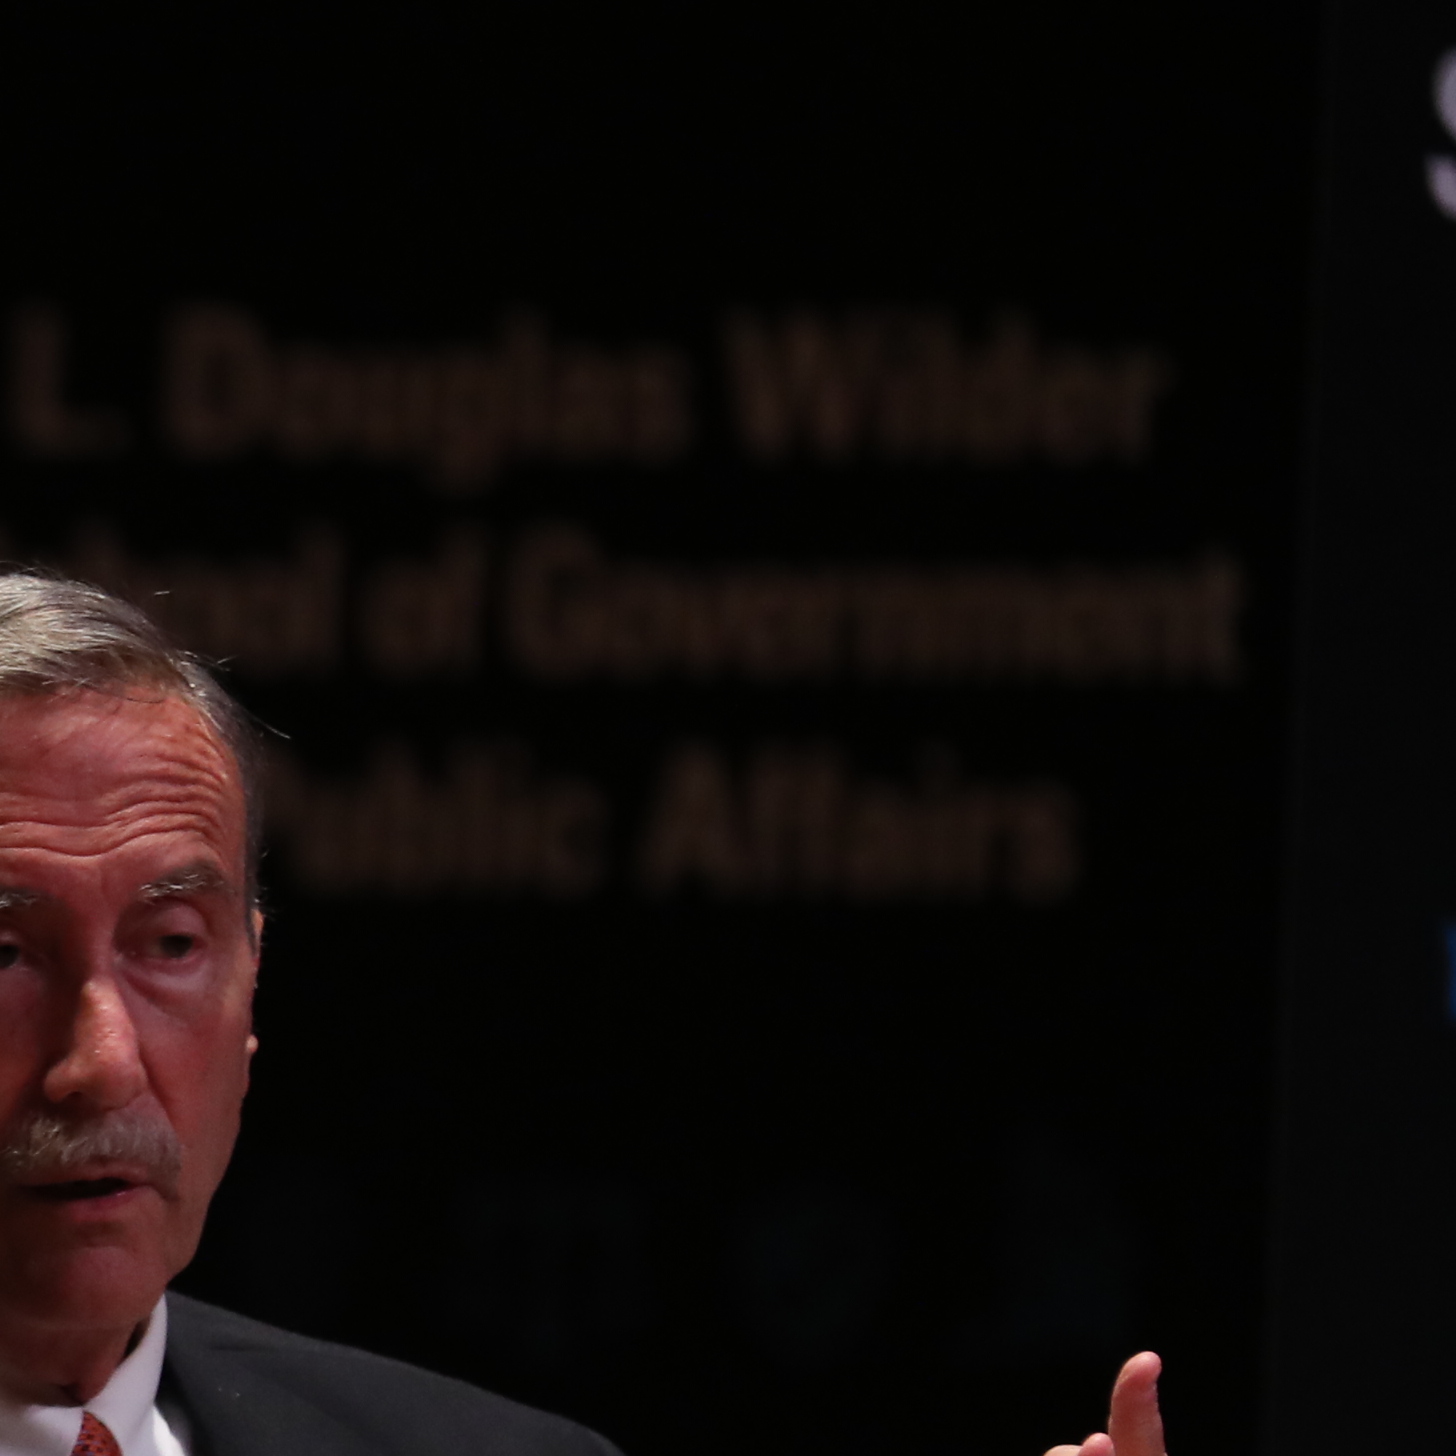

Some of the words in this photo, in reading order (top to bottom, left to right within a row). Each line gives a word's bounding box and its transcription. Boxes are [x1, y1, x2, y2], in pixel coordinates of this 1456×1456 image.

[5, 300, 126, 460] L.
[162, 300, 690, 492] Douglas
[722, 302, 1176, 466] Wilder
[368, 518, 490, 683] of
[504, 518, 1245, 688] Government
[640, 740, 1080, 900] Affairs
